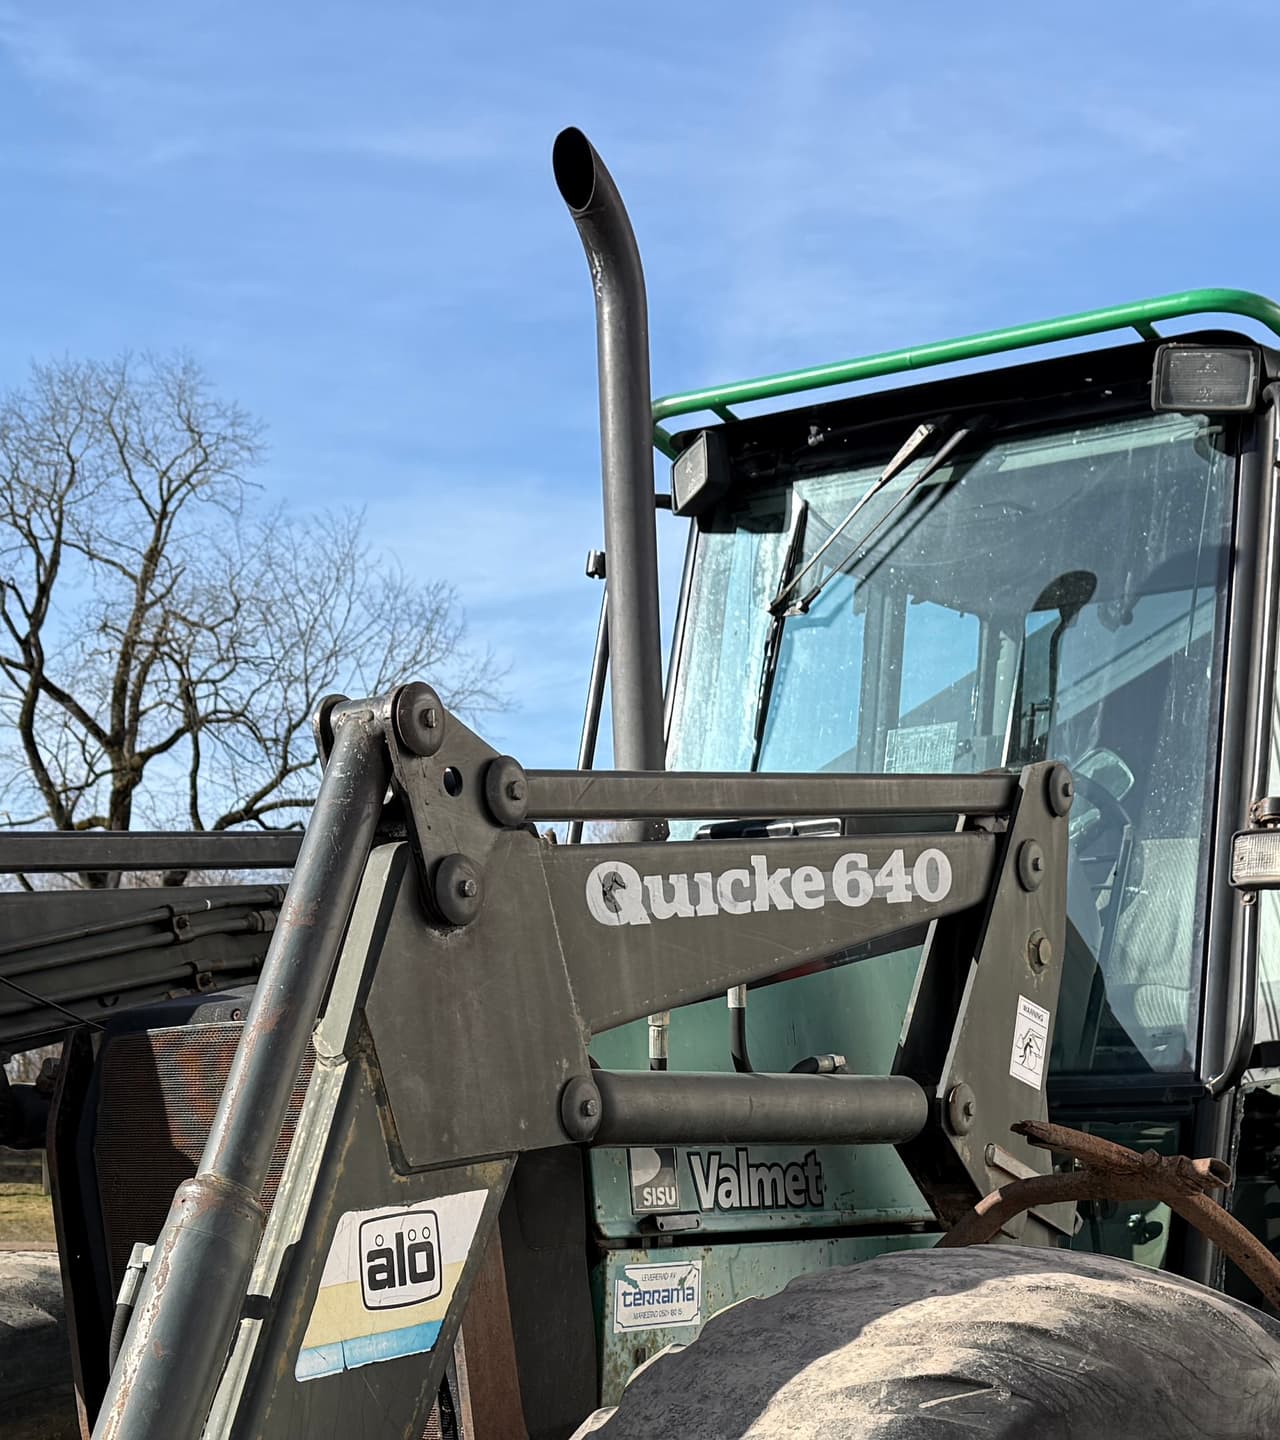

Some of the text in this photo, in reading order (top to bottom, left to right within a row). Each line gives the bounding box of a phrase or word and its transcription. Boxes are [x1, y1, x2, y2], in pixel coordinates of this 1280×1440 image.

[585, 848, 952, 926] Quicke 640
[642, 1187, 676, 1206] SISU
[688, 1149, 824, 1211] Valmet
